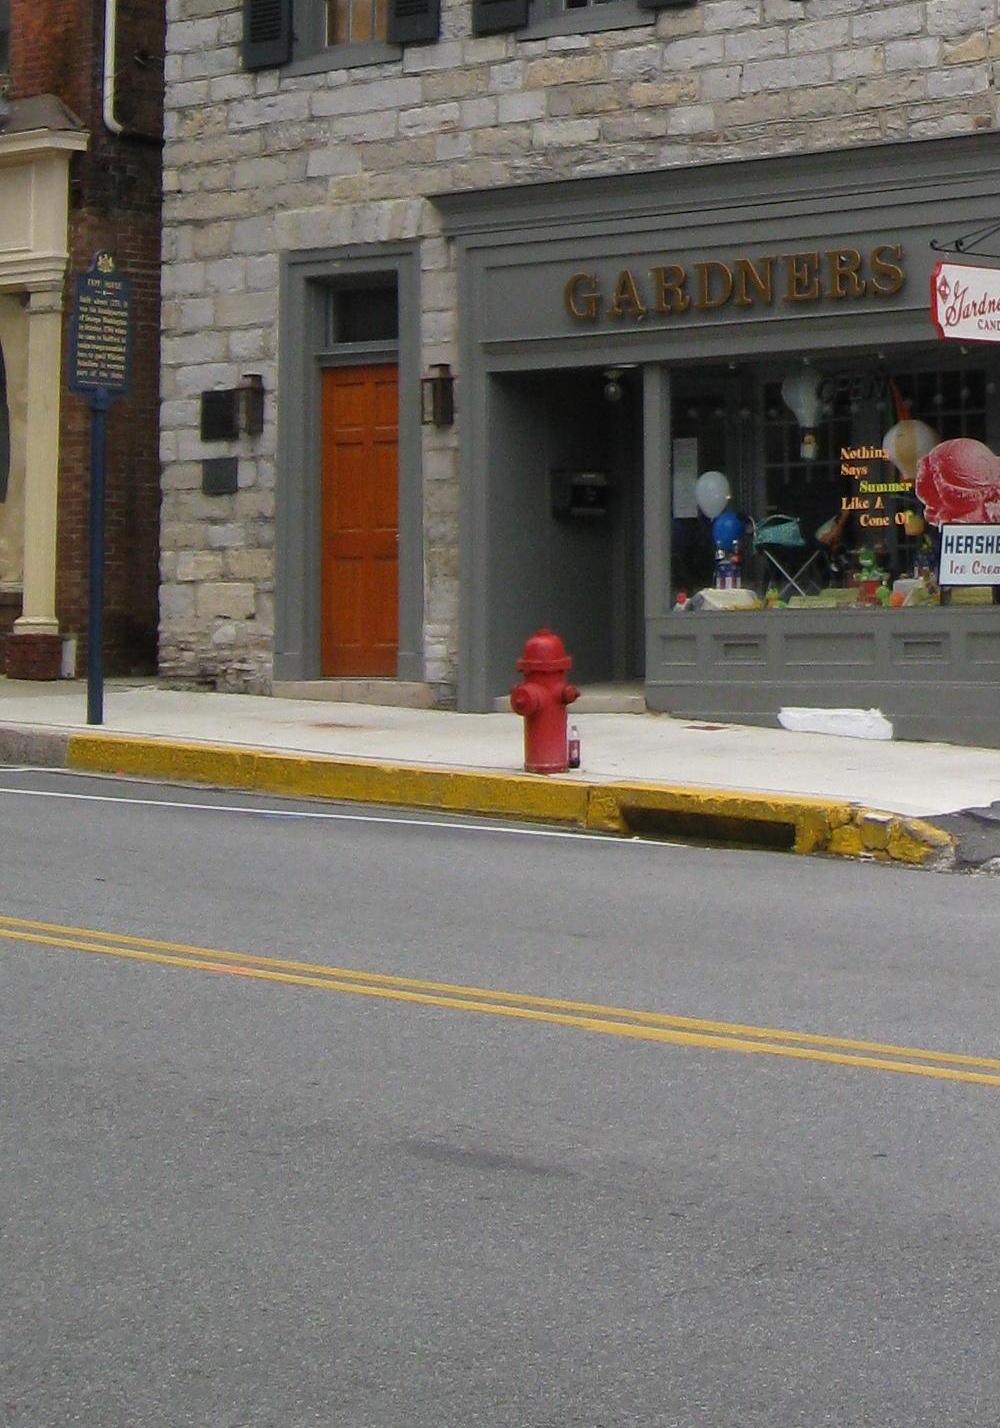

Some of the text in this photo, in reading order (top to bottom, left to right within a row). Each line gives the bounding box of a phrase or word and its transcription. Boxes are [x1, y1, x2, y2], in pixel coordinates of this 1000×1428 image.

[563, 243, 906, 320] GARDNERS
[840, 446, 889, 460] Nothing
[840, 463, 868, 479] Says
[860, 480, 912, 493] Summer
[841, 496, 885, 510] Like A
[859, 514, 890, 527] Cone
[949, 560, 966, 575] Ice
